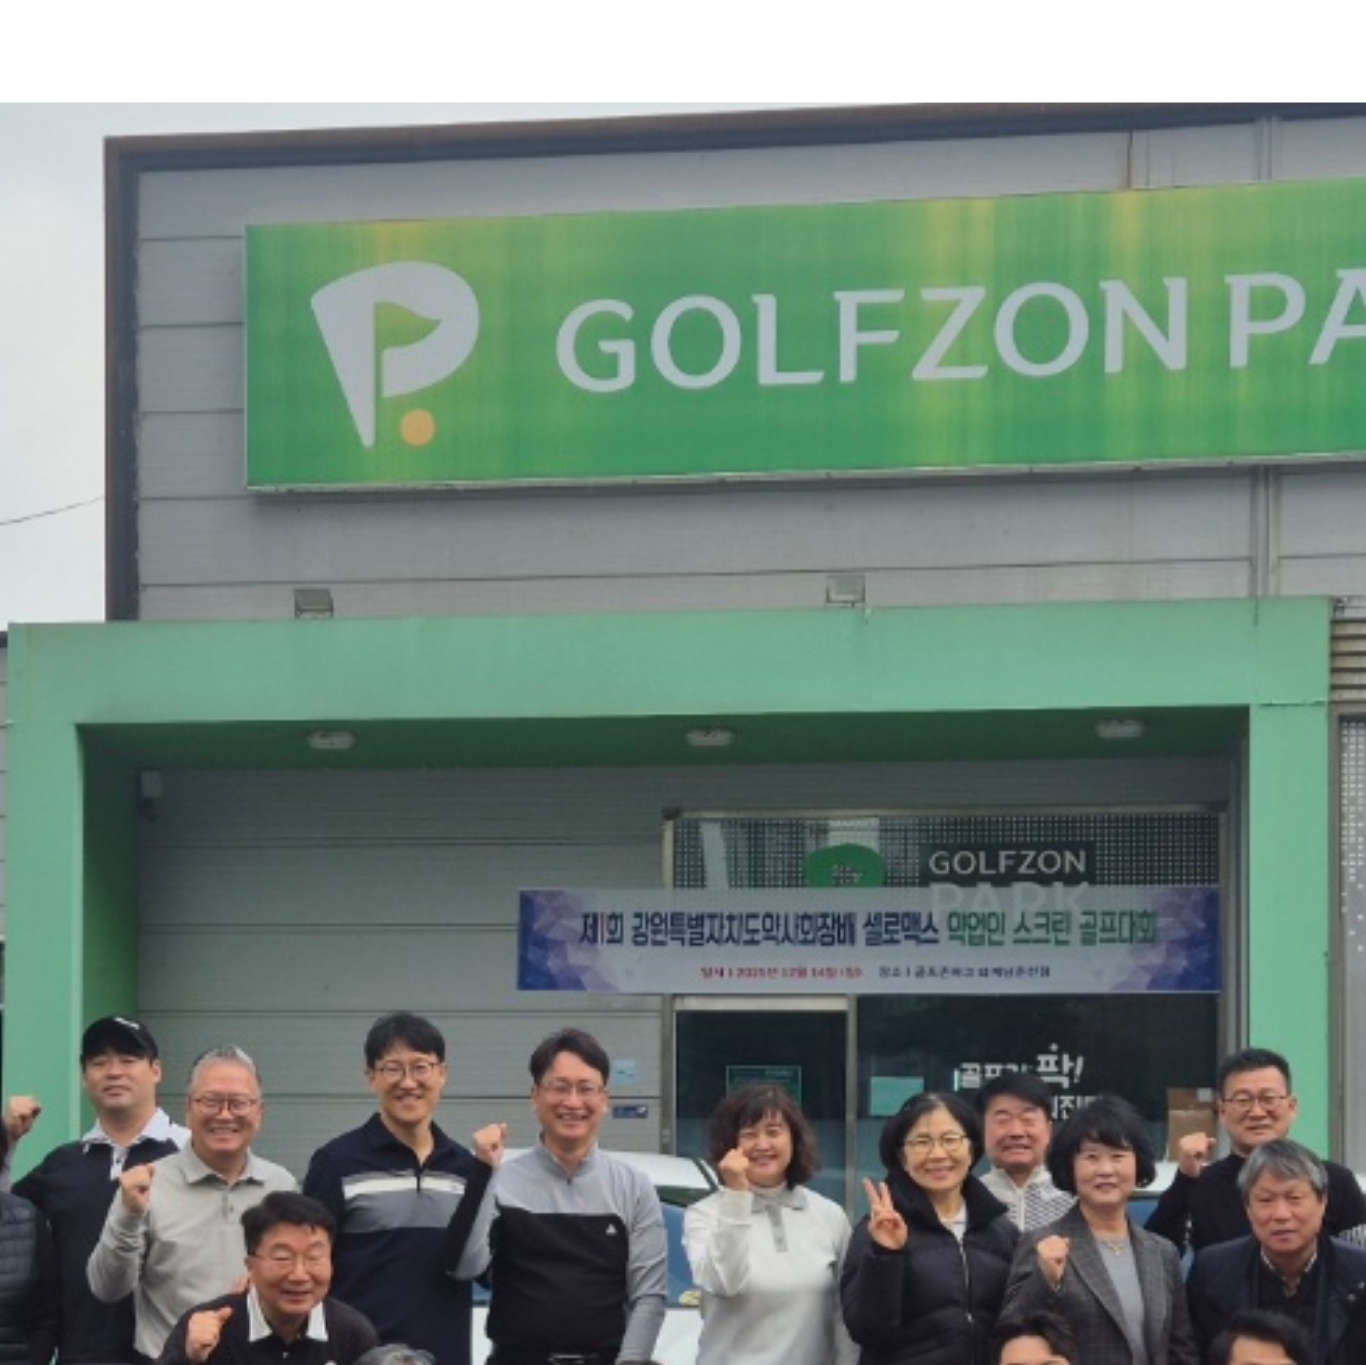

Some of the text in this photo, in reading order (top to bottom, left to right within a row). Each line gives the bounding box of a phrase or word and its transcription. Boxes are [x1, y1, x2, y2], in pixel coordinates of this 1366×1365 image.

[556, 275, 1187, 392] GOLFZON
[929, 850, 1087, 875] GOLFZON
[580, 911, 624, 946] 제1회
[863, 910, 940, 947] 셀로맥스
[947, 910, 1005, 947] 약업인
[1012, 910, 1072, 947] 스크린
[1079, 909, 1158, 947] 골프대회
